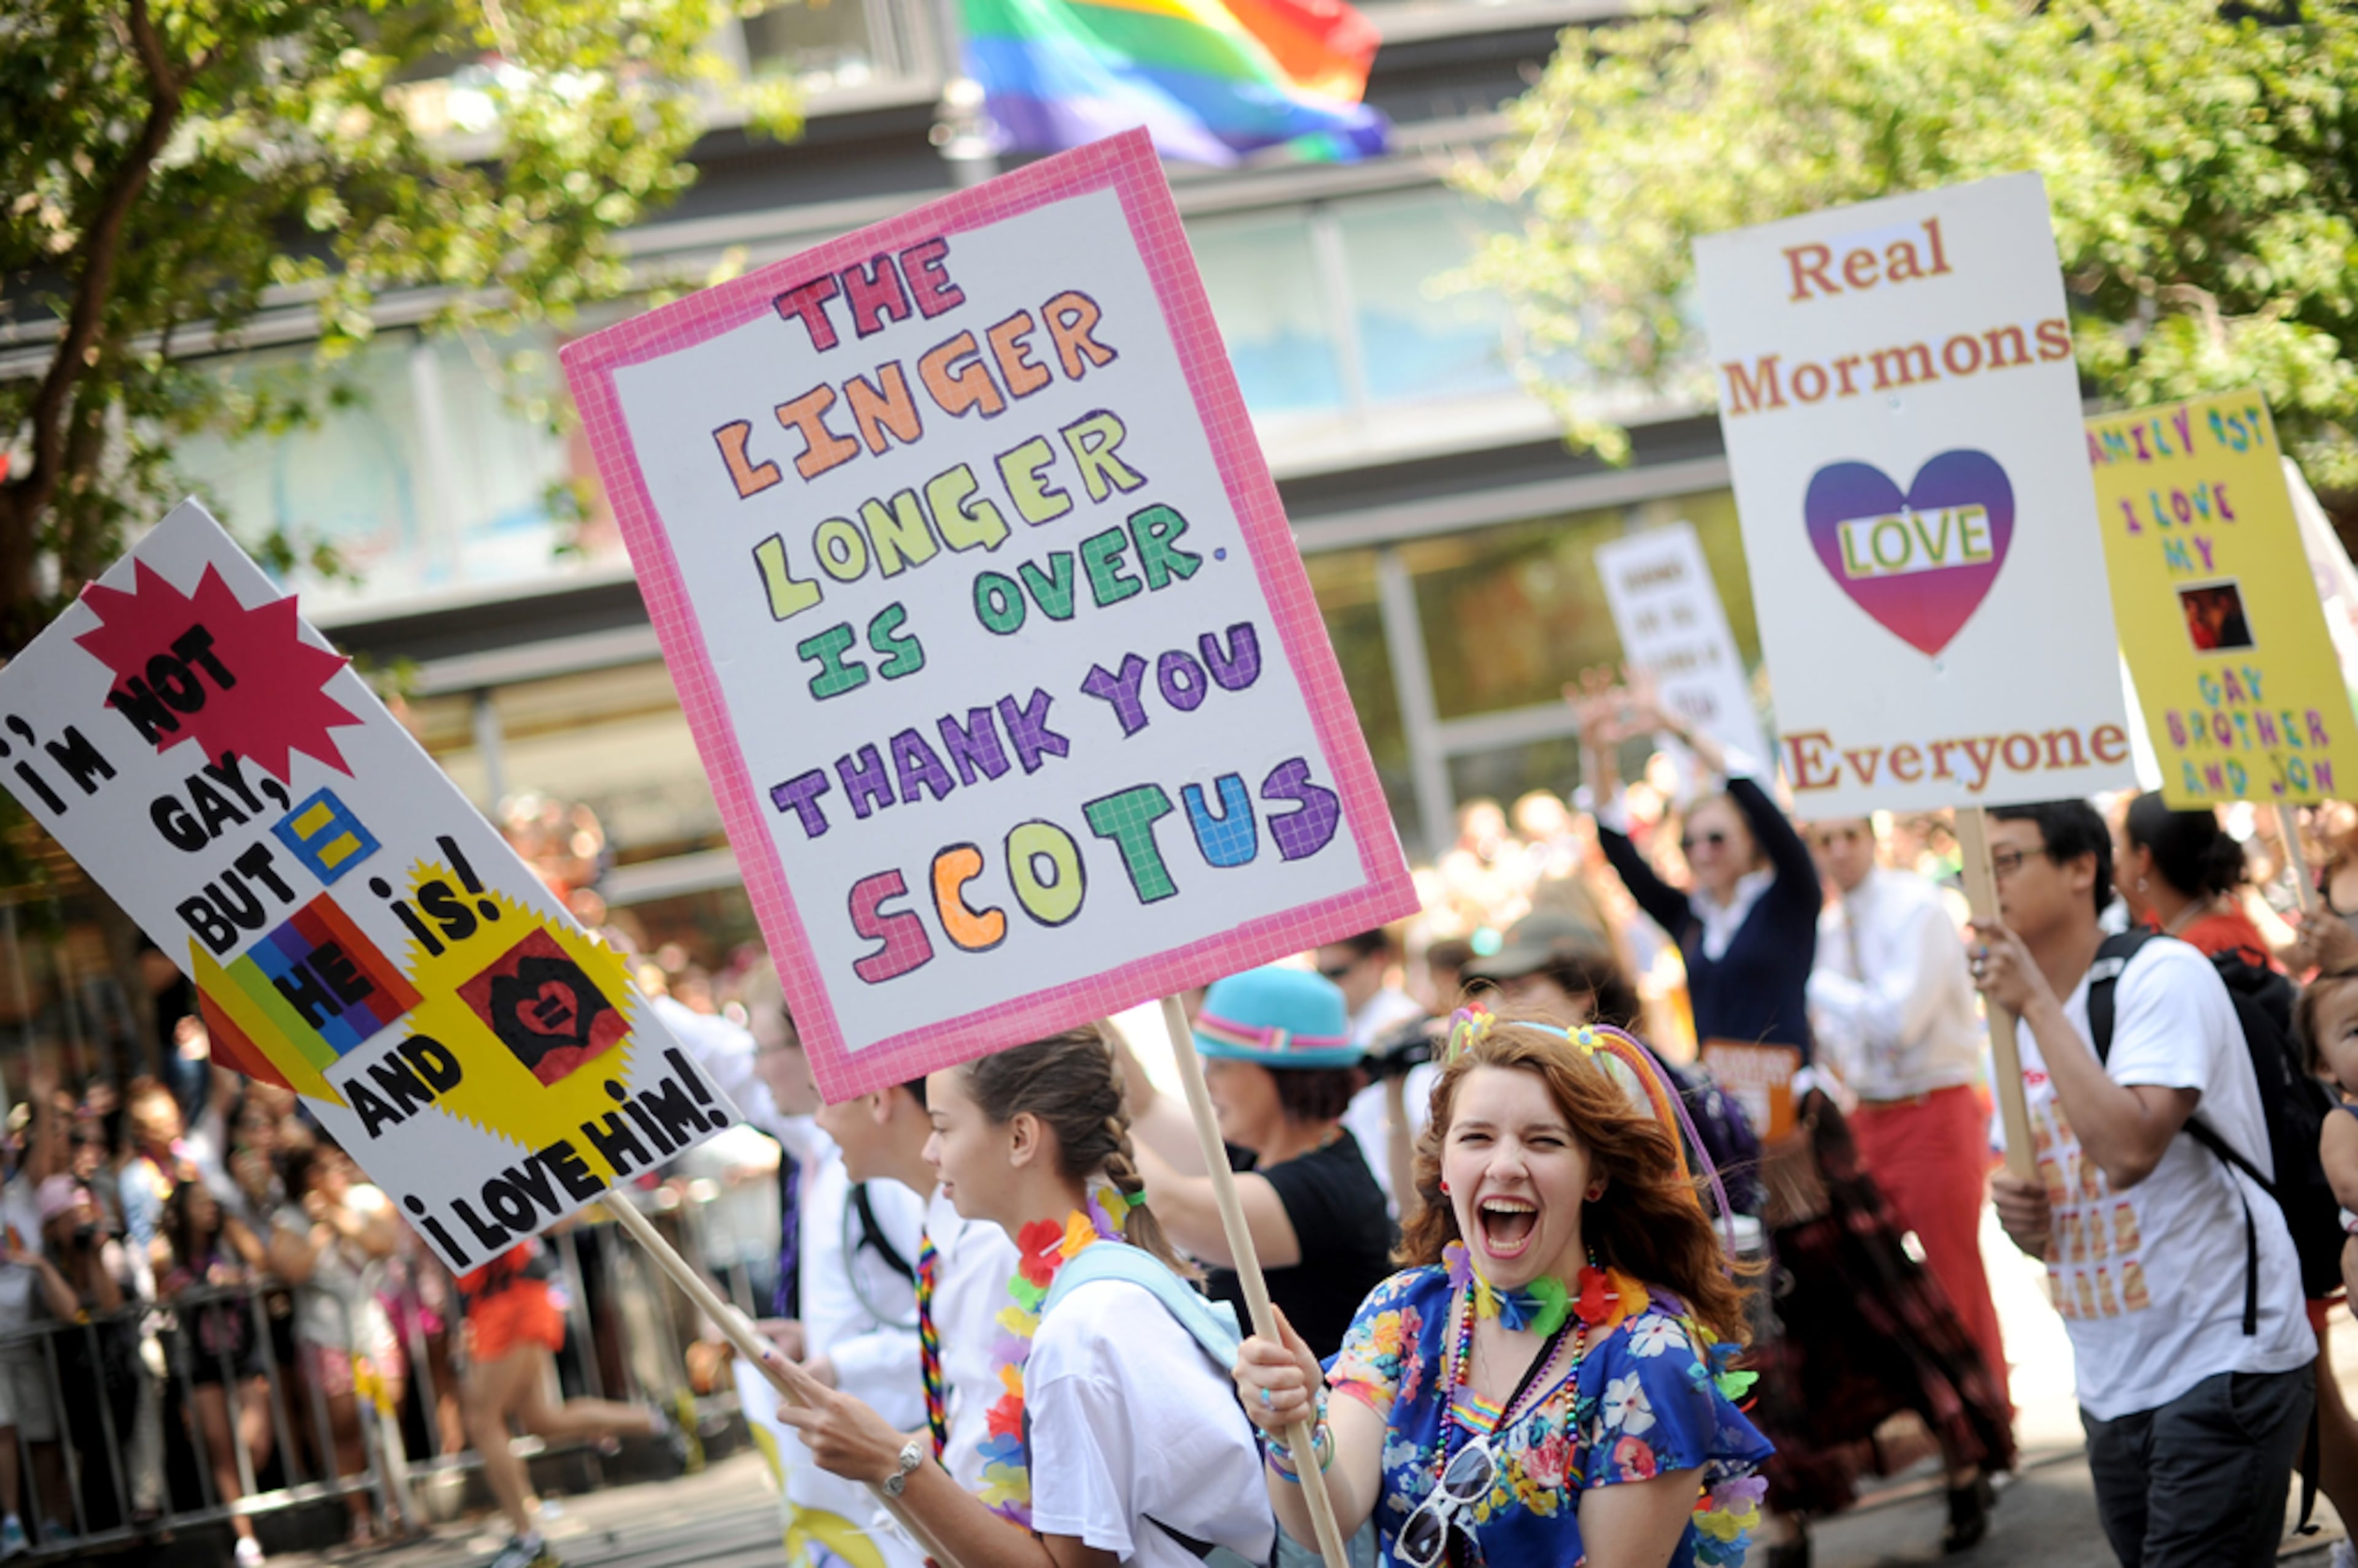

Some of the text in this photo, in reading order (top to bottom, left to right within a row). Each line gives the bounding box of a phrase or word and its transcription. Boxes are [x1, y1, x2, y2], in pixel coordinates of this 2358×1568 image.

[773, 236, 965, 353] THE
[1781, 217, 1953, 302] Real
[711, 290, 1119, 500] LINGER
[1721, 317, 2073, 417] Mormons
[2086, 405, 2193, 465] AMILY
[752, 408, 1148, 622] LONGER
[1842, 507, 1990, 576] LOVE
[2120, 483, 2235, 534] I LOVE
[2163, 536, 2214, 572] MY
[797, 502, 1227, 700] IS OVER.
[109, 623, 236, 745] NOT
[769, 621, 1261, 839] THANK YOU
[2166, 710, 2329, 750] BROTHER
[2198, 666, 2263, 708] GAY
[150, 750, 290, 852] GAY,
[1783, 723, 2130, 793] Everyone
[2182, 758, 2247, 796] AND
[175, 841, 295, 955] BUT
[847, 756, 1340, 984] SCOTUS
[272, 942, 375, 1030] HE
[343, 1034, 462, 1139] AND
[449, 1139, 605, 1250] LOVE
